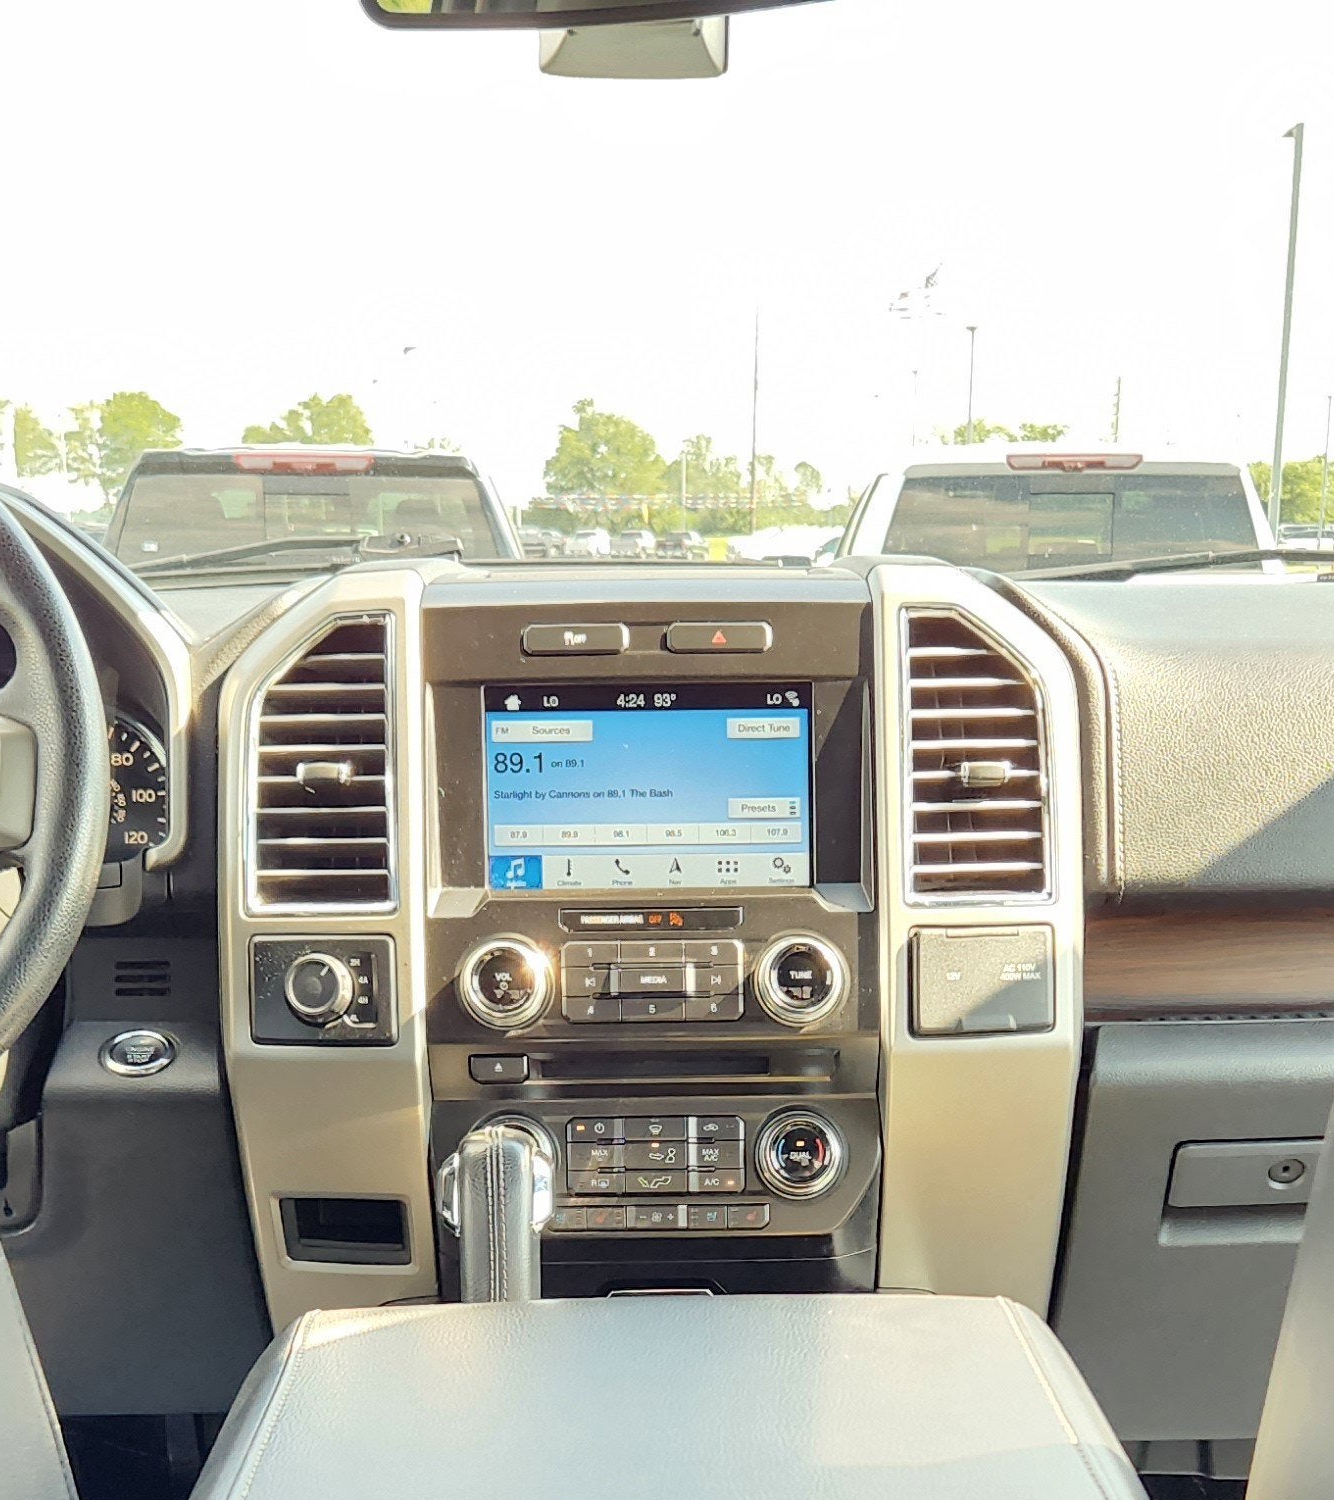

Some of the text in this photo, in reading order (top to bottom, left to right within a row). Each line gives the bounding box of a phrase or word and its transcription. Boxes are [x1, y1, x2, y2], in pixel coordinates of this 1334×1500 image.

[543, 695, 559, 707] LO
[616, 694, 645, 708] 4:24
[766, 694, 783, 705] LO
[532, 726, 571, 735] Sources
[738, 723, 791, 733] Direct Tune
[111, 752, 134, 767] 80
[493, 752, 543, 774] 89.1
[565, 759, 585, 768] 89.1
[131, 789, 156, 803] 100
[493, 790, 533, 801] Starlight
[535, 790, 547, 801] by
[548, 789, 591, 799] Cannons
[607, 789, 626, 798] 89.1
[629, 789, 647, 797] The
[649, 788, 673, 798] Bash
[741, 804, 777, 812] Presets
[767, 828, 788, 836] 107.9
[124, 831, 148, 845] 120
[557, 879, 582, 887] Climate
[494, 972, 513, 981] VOL
[640, 975, 668, 984] MEDIA
[789, 970, 813, 979] TUNE
[1023, 972, 1042, 980] MAX
[648, 1004, 656, 1014] 5
[704, 1178, 720, 1186] A/C
